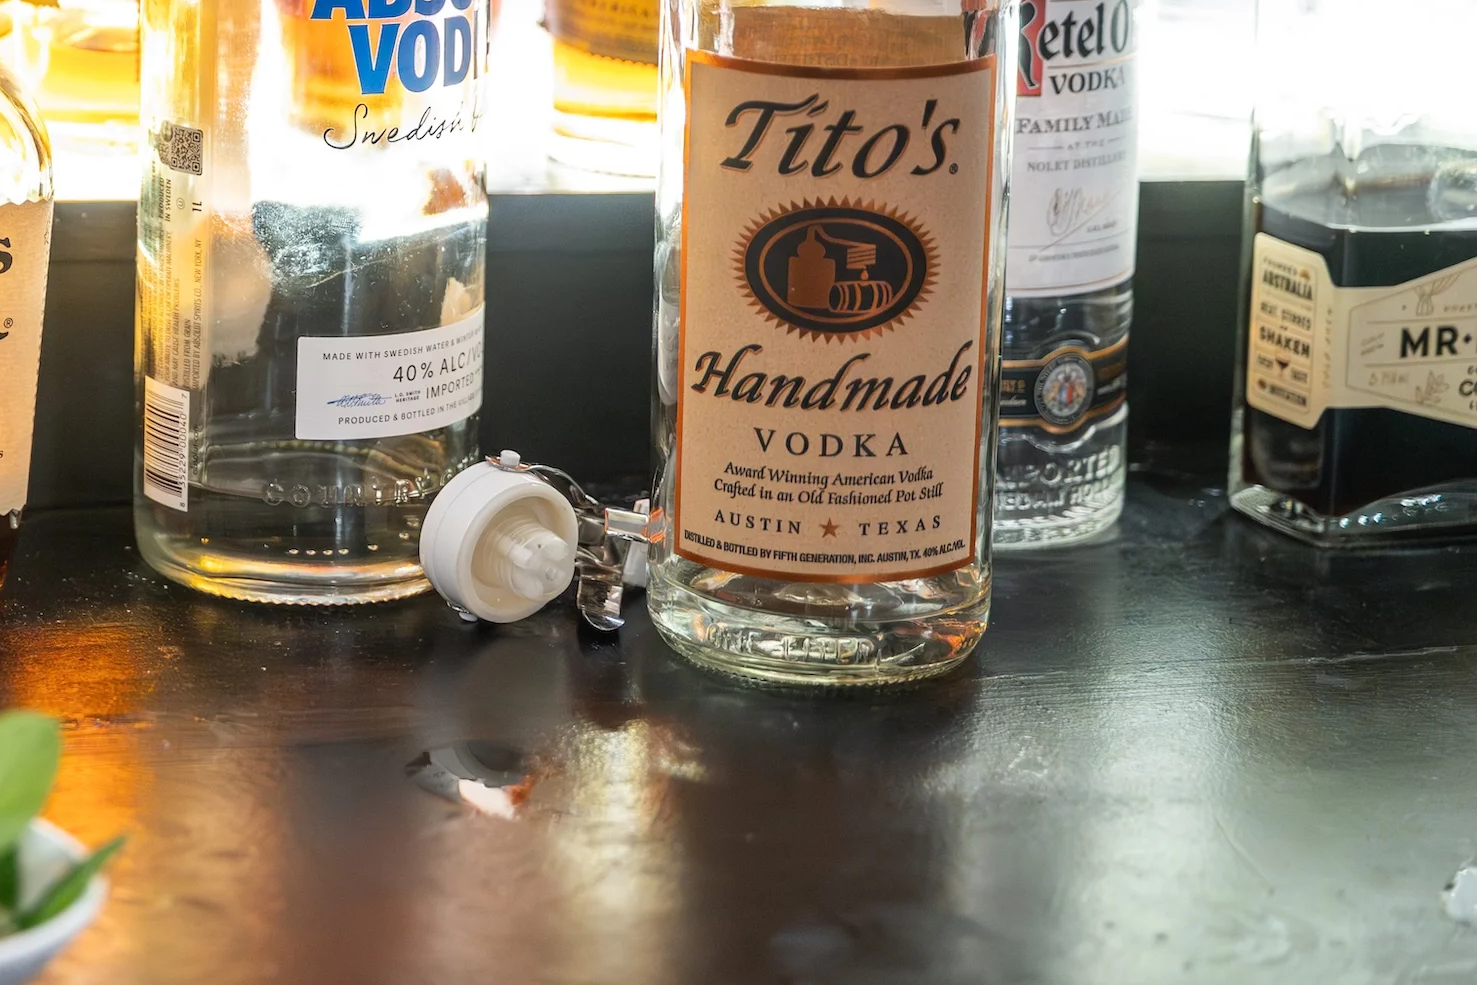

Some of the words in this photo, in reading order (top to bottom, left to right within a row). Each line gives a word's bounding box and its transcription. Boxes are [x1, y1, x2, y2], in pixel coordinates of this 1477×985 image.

[347, 15, 473, 95] VOD
[323, 103, 465, 150] Swedish
[720, 92, 961, 179] Tito's
[1016, 117, 1095, 134] FAMILY
[1027, 160, 1070, 173] NOLET
[192, 201, 202, 213] 1L
[195, 238, 201, 248] NY
[192, 250, 202, 266] YORK,
[193, 268, 201, 283] NEW
[1263, 270, 1313, 301] AUSTRALIA
[192, 298, 201, 321] SPIRITS
[183, 319, 191, 337] GRAIN
[192, 322, 201, 349] ABSOLUT
[183, 338, 191, 357] FROM
[323, 352, 351, 361] MADE
[384, 346, 423, 357] SWEDISH
[426, 341, 449, 352] WATER
[1259, 326, 1310, 359] SHAKEN
[1400, 325, 1459, 358] MR
[193, 350, 201, 358] BY
[393, 361, 434, 383] 40%
[691, 339, 974, 413] Handmade
[426, 375, 473, 399] IMPORTED
[338, 415, 389, 425] PRODUCED
[401, 408, 435, 421] BOTTLED
[446, 402, 457, 411] THE
[754, 426, 908, 458] VODKA
[724, 462, 766, 481] Award
[768, 467, 829, 491] Winning
[832, 470, 896, 487] American
[898, 466, 934, 484] Vodka
[714, 478, 756, 500] Crafted
[759, 486, 773, 501] in
[777, 489, 793, 503] an
[798, 489, 824, 505] Old
[827, 489, 892, 506] Fashioned
[895, 487, 916, 504] Pot
[919, 482, 944, 500] Still
[714, 509, 802, 535] AUSTIN
[859, 516, 941, 537] TEXAS
[684, 529, 715, 549] DISTILLED
[715, 539, 723, 550] &
[723, 541, 758, 557] BOTTLED
[760, 546, 772, 559] BY
[774, 550, 798, 562] FIFTH
[799, 552, 857, 565] GENERATION,
[859, 552, 875, 564] INC.
[877, 551, 909, 563] AUSTIN,
[909, 548, 922, 560] TX.
[923, 545, 939, 558] 40%
